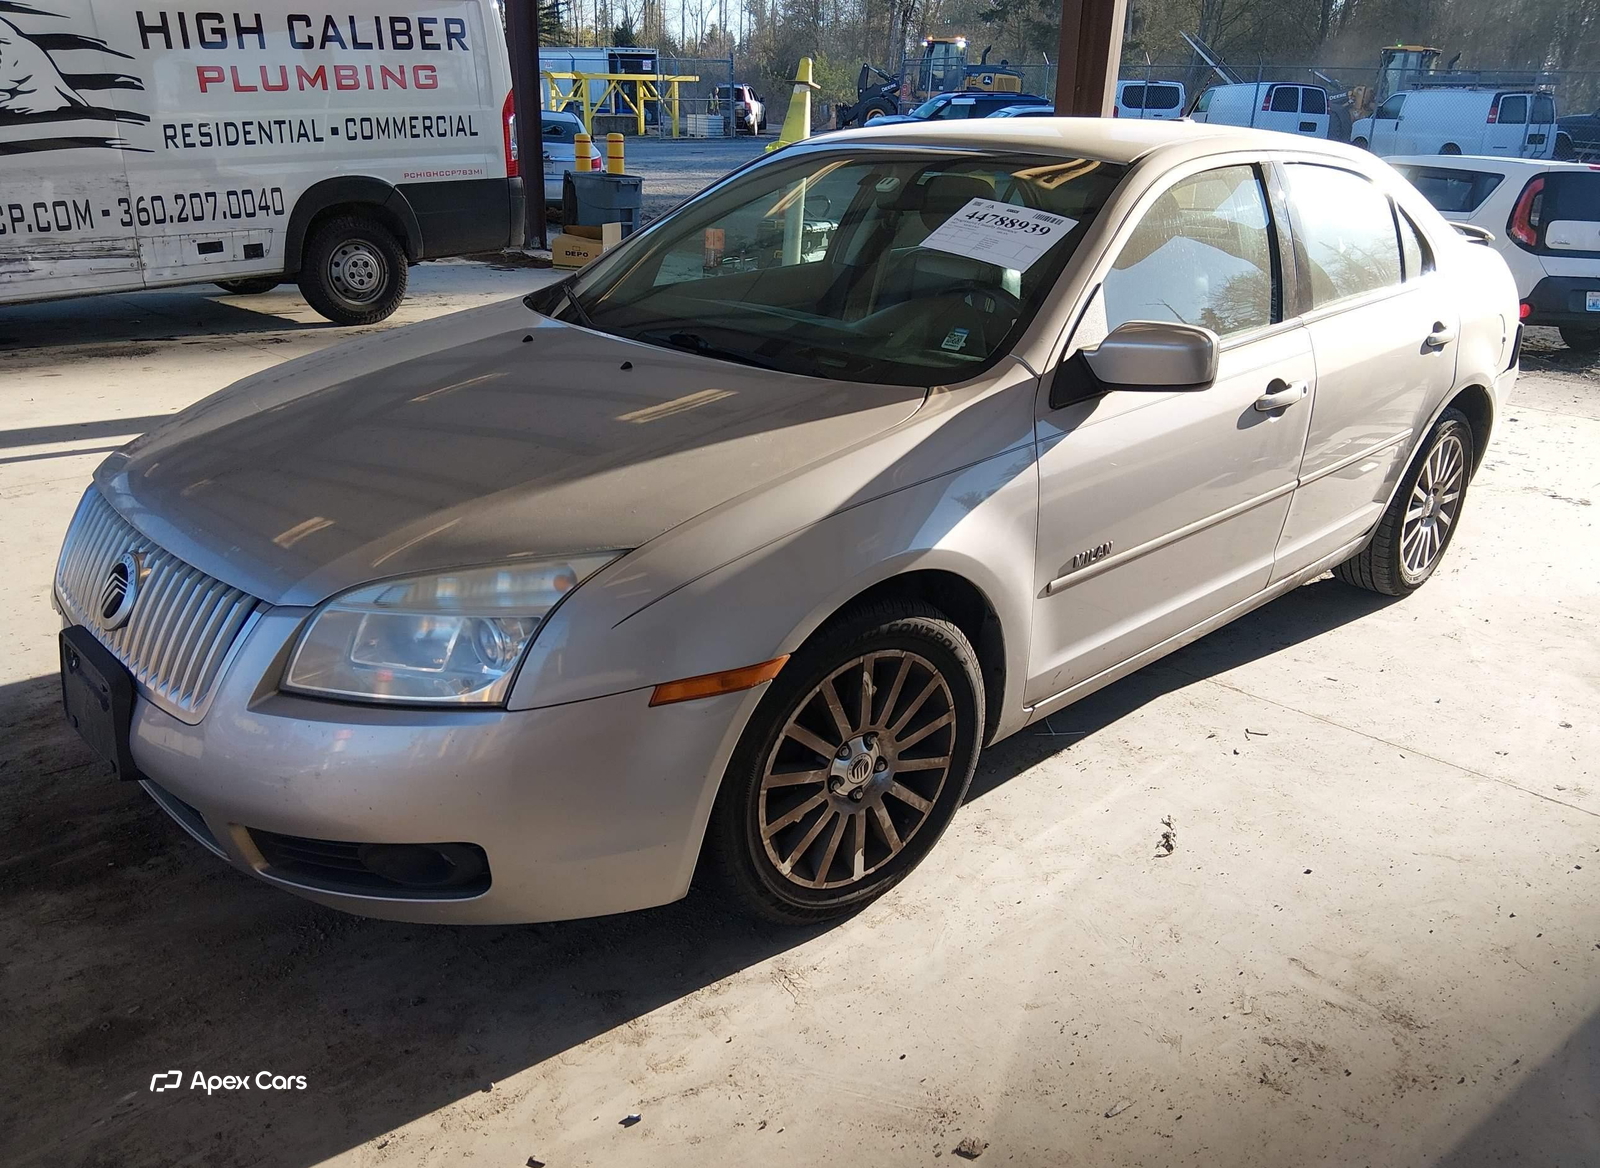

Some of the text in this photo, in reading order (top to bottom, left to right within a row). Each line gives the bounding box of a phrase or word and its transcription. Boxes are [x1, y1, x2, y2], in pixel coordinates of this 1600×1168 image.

[135, 10, 470, 51] HIGH CALIBER
[196, 64, 439, 93] PLUMBING
[162, 114, 479, 149] RESIDENTIAL COMMERCIAL
[117, 187, 285, 227] 360.207.0040
[965, 210, 1051, 236] 44788939
[565, 250, 589, 258] DEPO
[1072, 540, 1114, 569] MILAN
